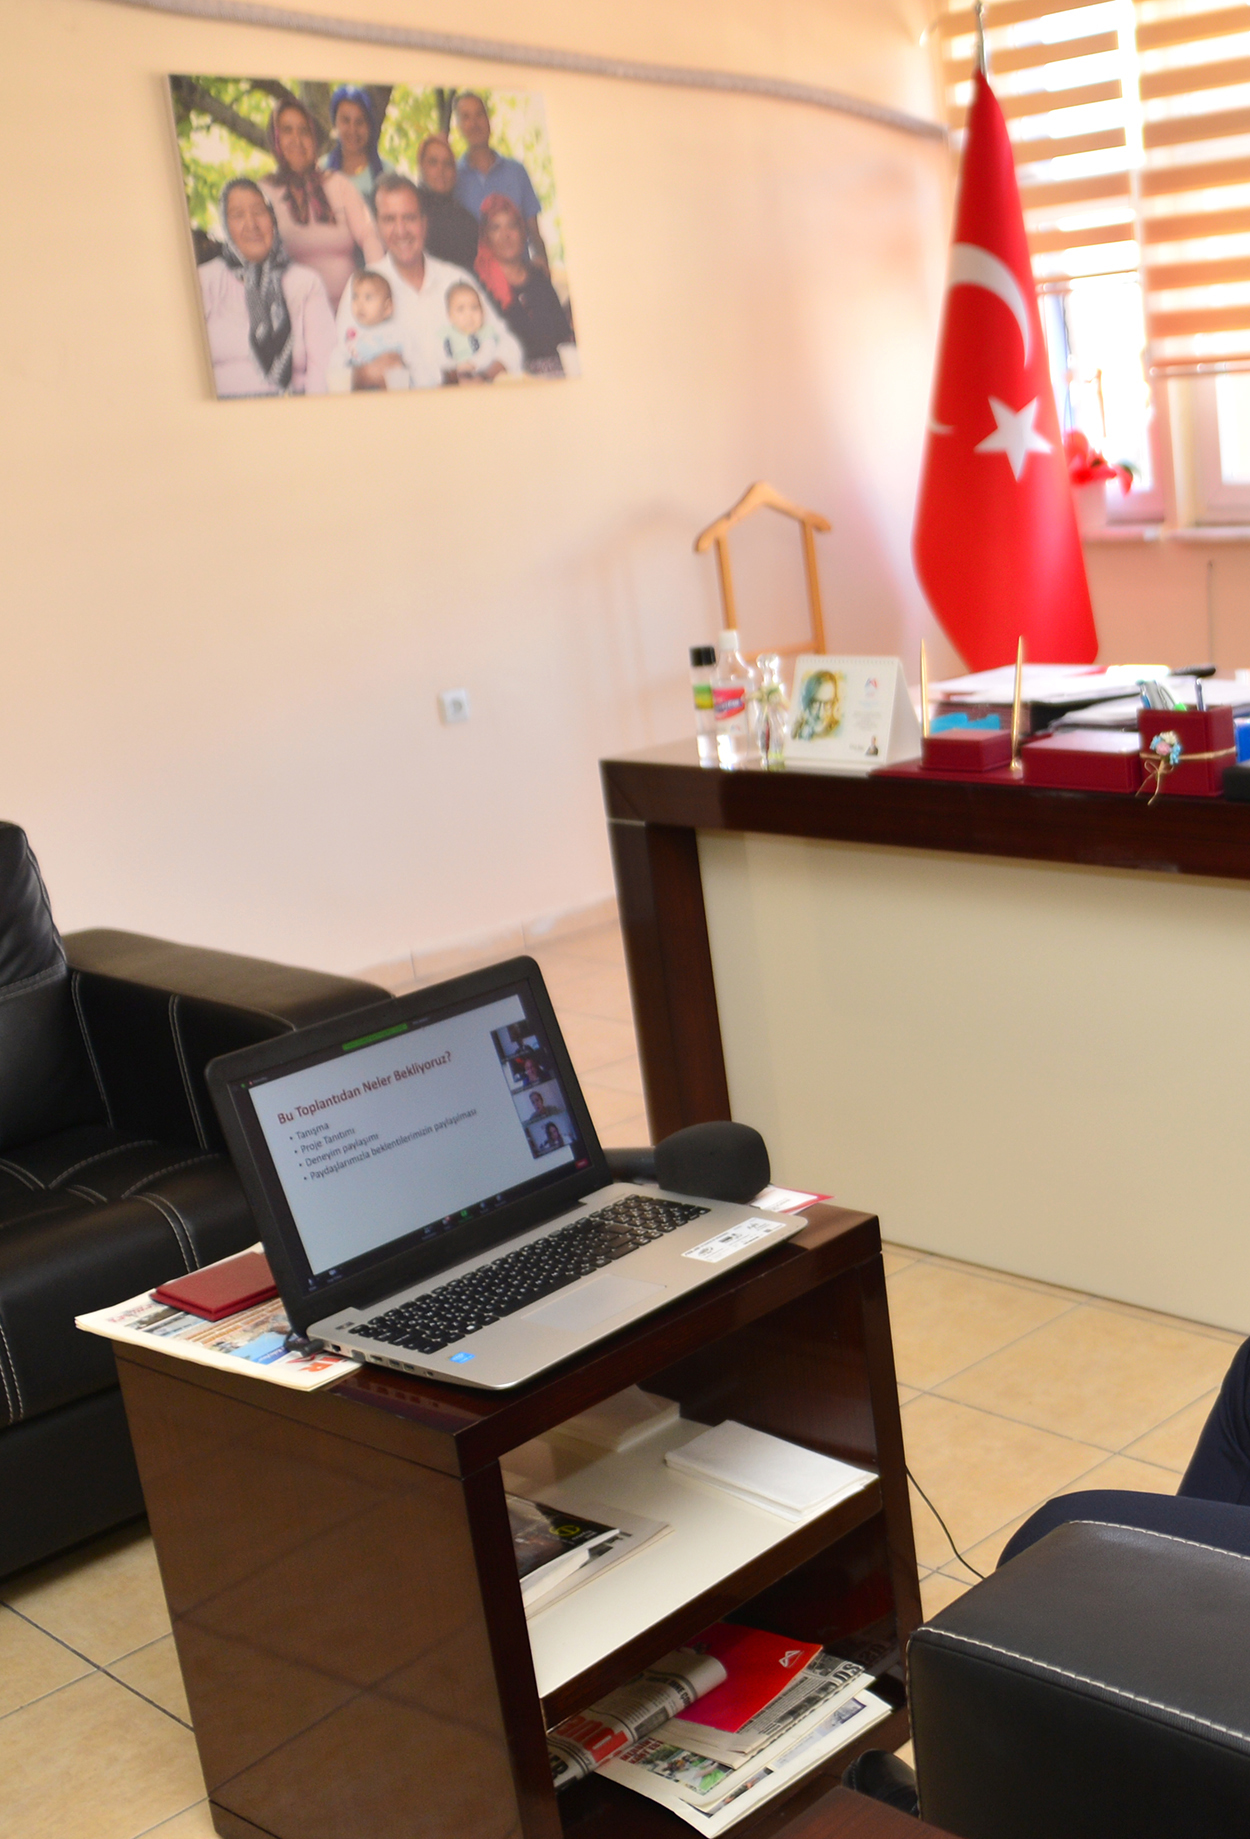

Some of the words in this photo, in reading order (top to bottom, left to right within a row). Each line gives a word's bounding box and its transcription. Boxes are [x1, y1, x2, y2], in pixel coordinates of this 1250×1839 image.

[277, 1111, 294, 1125] Bu
[294, 1086, 361, 1117] Toplantıdan
[362, 1074, 392, 1092] Neler
[393, 1050, 452, 1082] Bekliyoruz?
[295, 1122, 330, 1140] Tanışma
[300, 1140, 323, 1154] Proje
[322, 1127, 356, 1146] Tanıtımı
[305, 1149, 342, 1167] Deneyim
[342, 1132, 379, 1154] paylaşımı
[310, 1152, 371, 1180] Paydaşlarımızla
